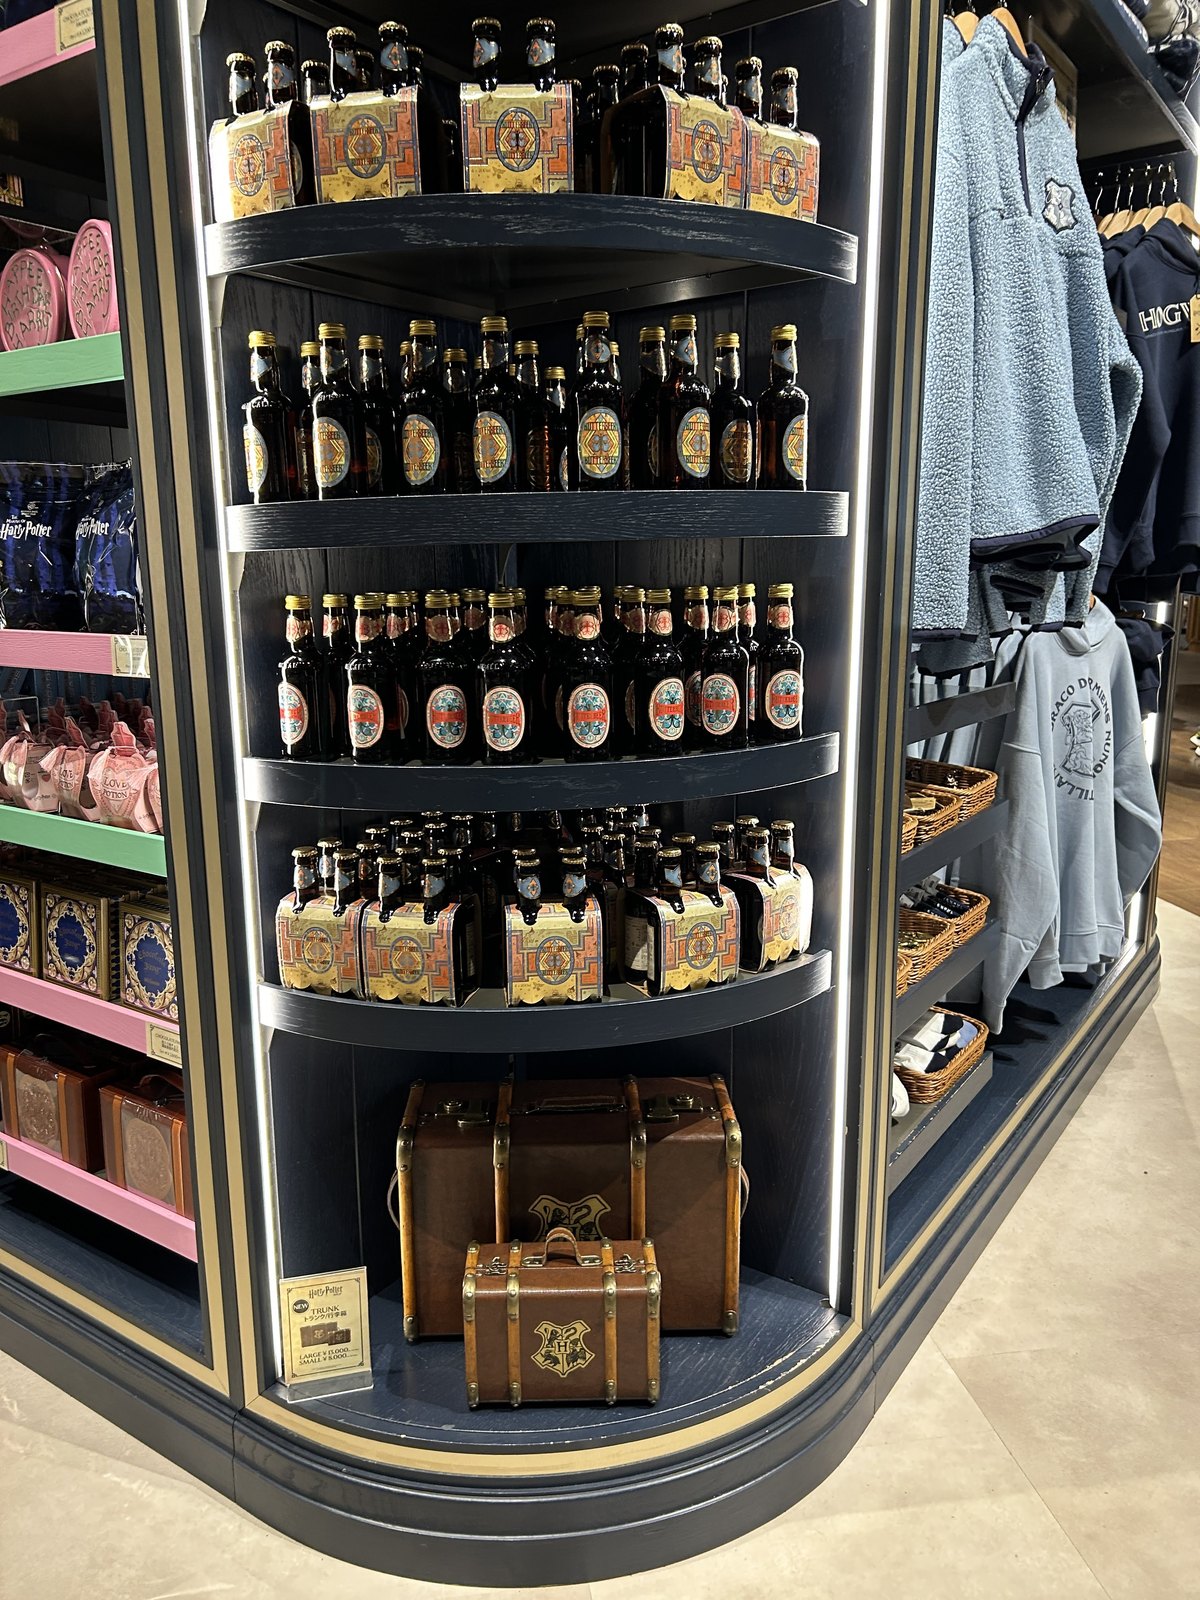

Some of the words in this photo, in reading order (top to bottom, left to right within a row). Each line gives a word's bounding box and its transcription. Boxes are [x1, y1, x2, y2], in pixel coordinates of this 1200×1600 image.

[0, 523, 26, 540] Harry
[25, 521, 52, 541] Potter
[1092, 730, 1112, 777] NUNQ
[103, 776, 128, 788] LOVE
[102, 788, 128, 798] POTION
[309, 1288, 325, 1299] Harry
[325, 1285, 343, 1296] Potter
[311, 1305, 339, 1315] TRUNK
[299, 1351, 322, 1360] LARGE
[299, 1357, 322, 1366] SMALL
